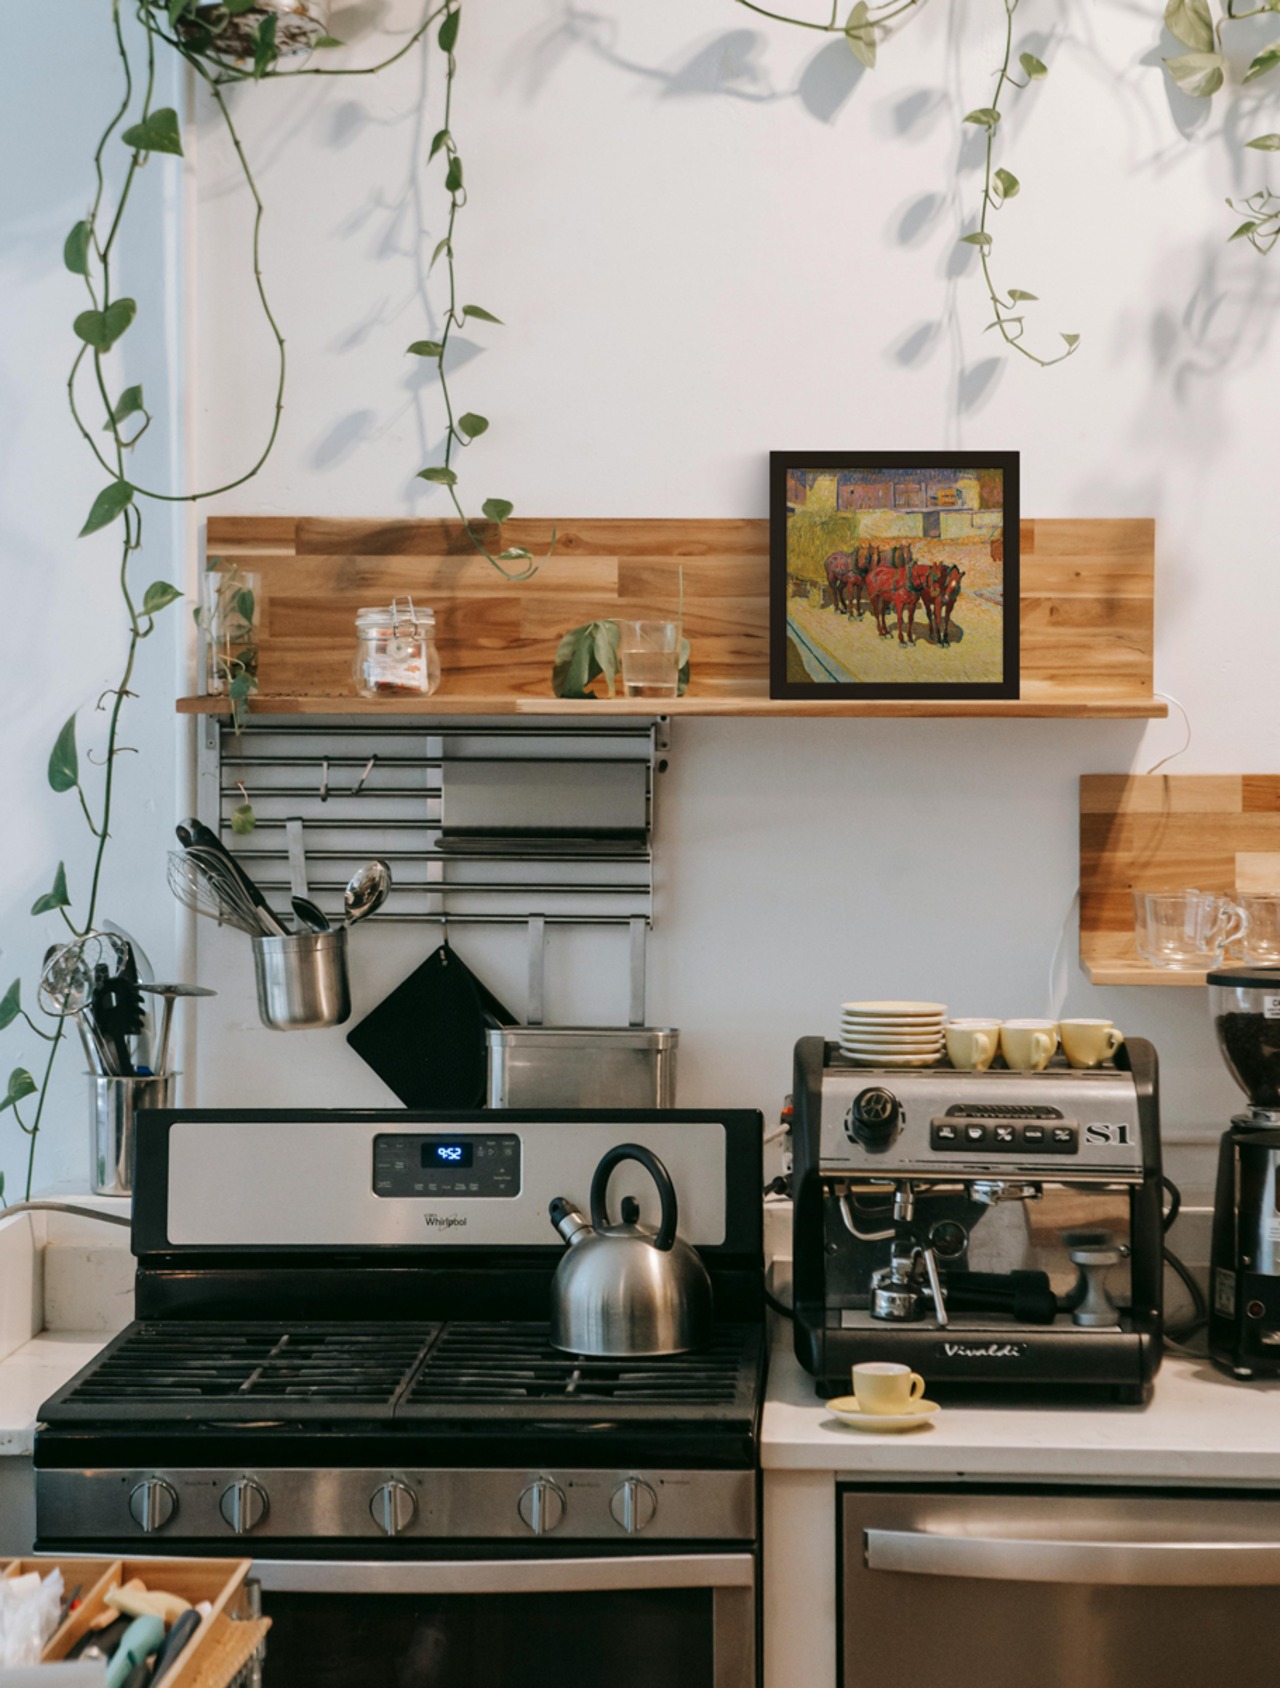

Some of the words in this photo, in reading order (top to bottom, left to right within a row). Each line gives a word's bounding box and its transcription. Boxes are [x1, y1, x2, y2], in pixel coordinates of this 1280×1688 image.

[1085, 1123, 1133, 1145] S1
[425, 1217, 467, 1228] Whirlpool
[944, 1343, 1020, 1357] Vivaldi
